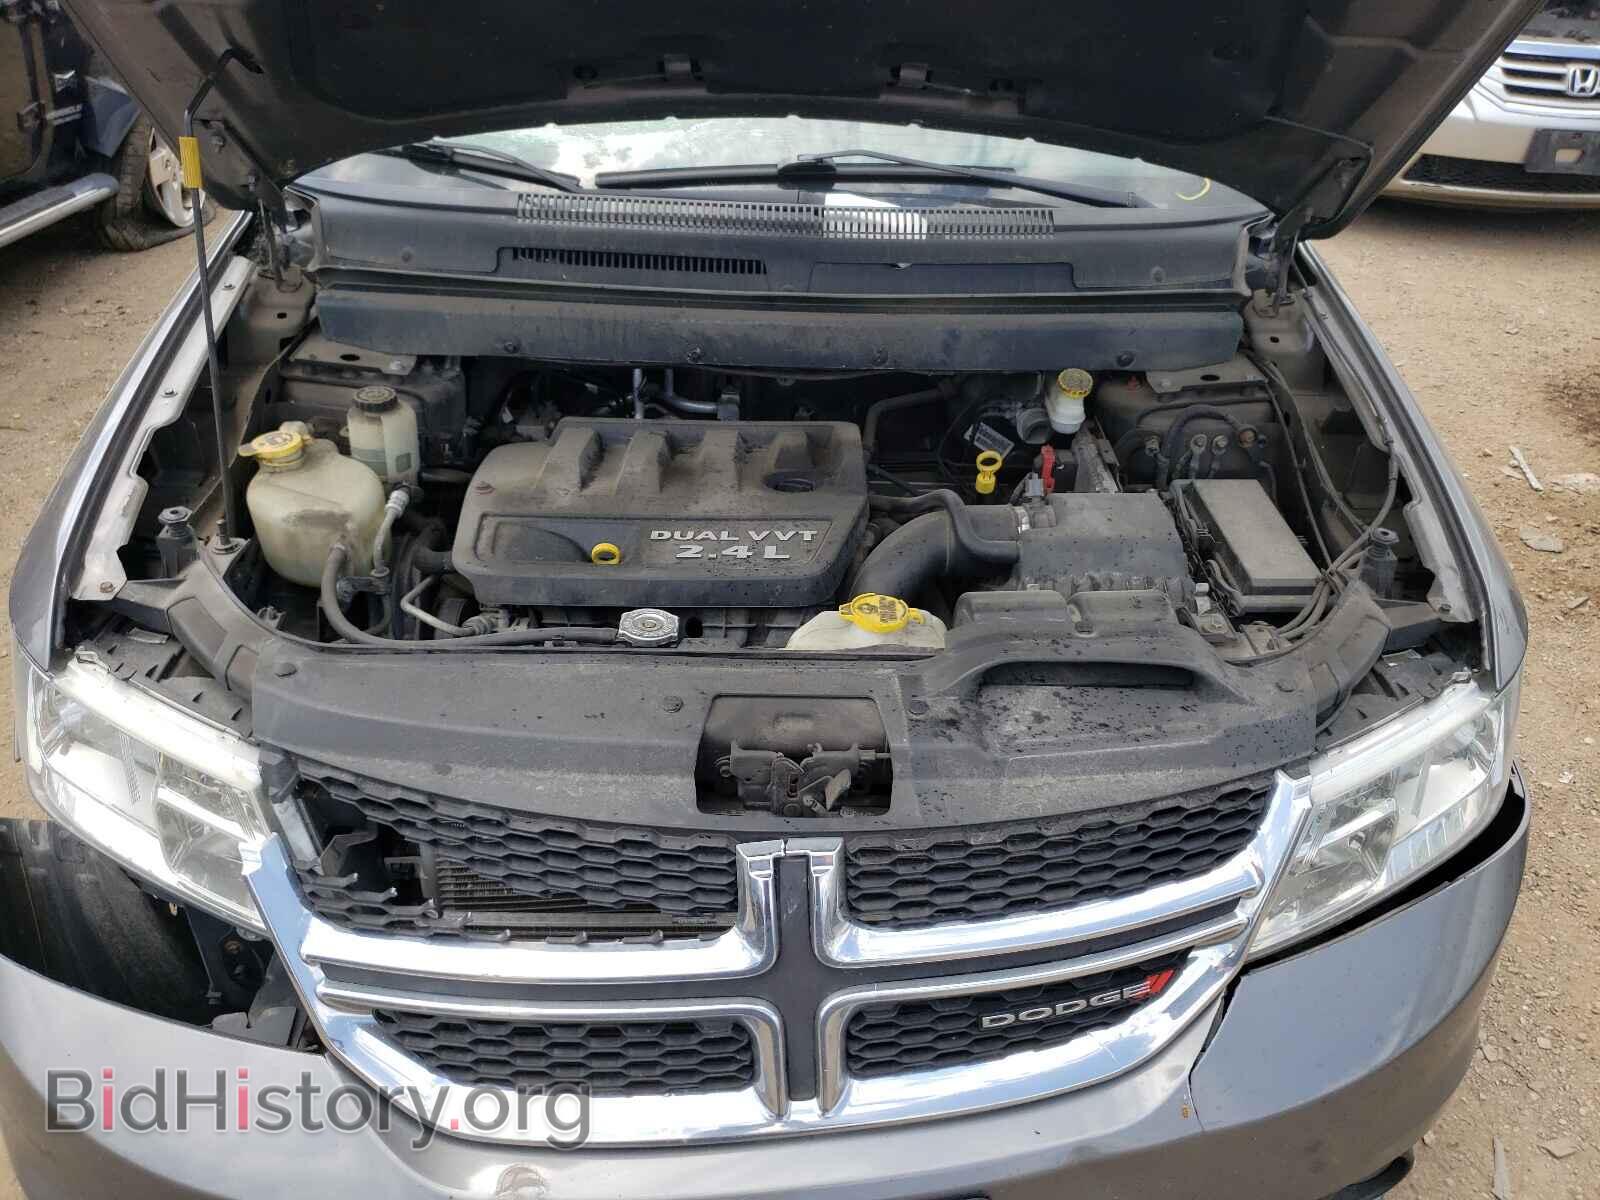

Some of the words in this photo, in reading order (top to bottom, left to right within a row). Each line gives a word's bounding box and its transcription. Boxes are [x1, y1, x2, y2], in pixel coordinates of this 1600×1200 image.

[649, 530, 740, 541] DUAL
[748, 530, 818, 541] VVT
[981, 981, 1151, 1029] DODGE
